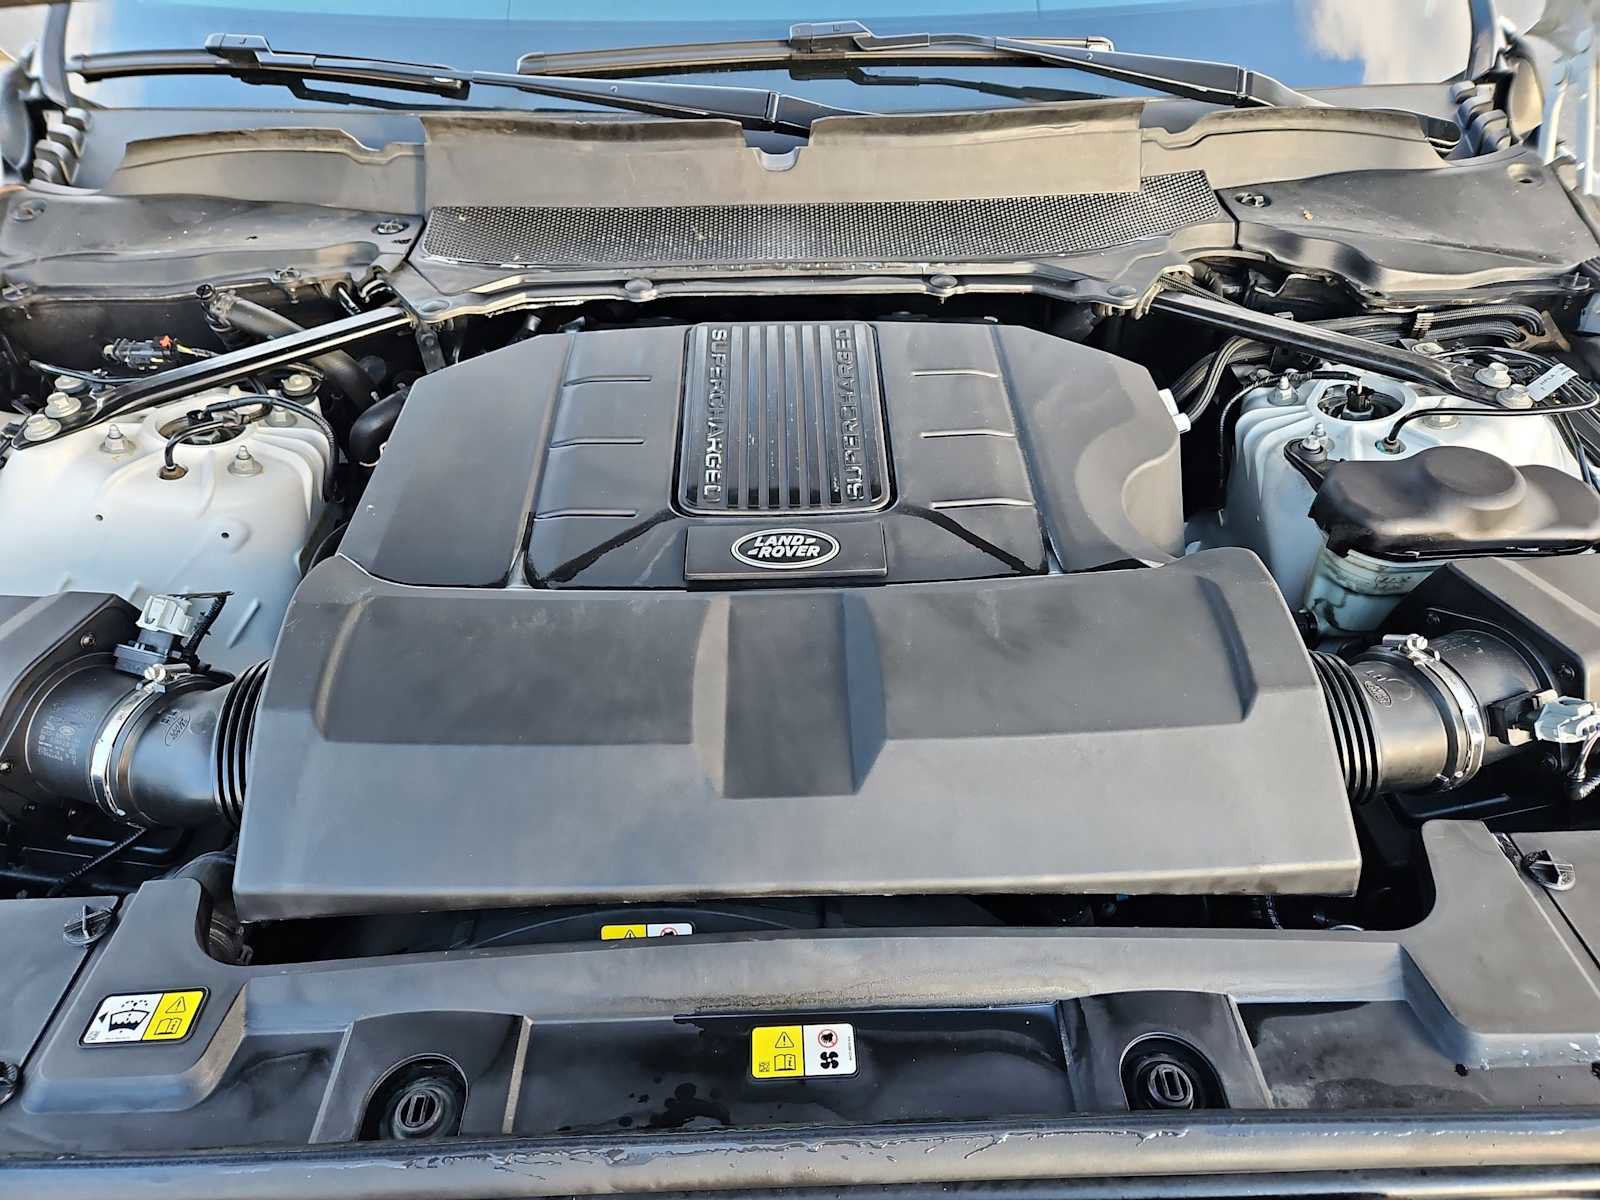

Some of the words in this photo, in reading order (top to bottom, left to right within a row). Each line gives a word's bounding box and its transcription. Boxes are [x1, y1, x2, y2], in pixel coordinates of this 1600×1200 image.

[703, 328, 728, 503] SUPERCHARGED
[834, 328, 865, 500] SUPERCHARGED
[754, 535, 805, 547] LAND
[757, 545, 820, 558] ROVER
